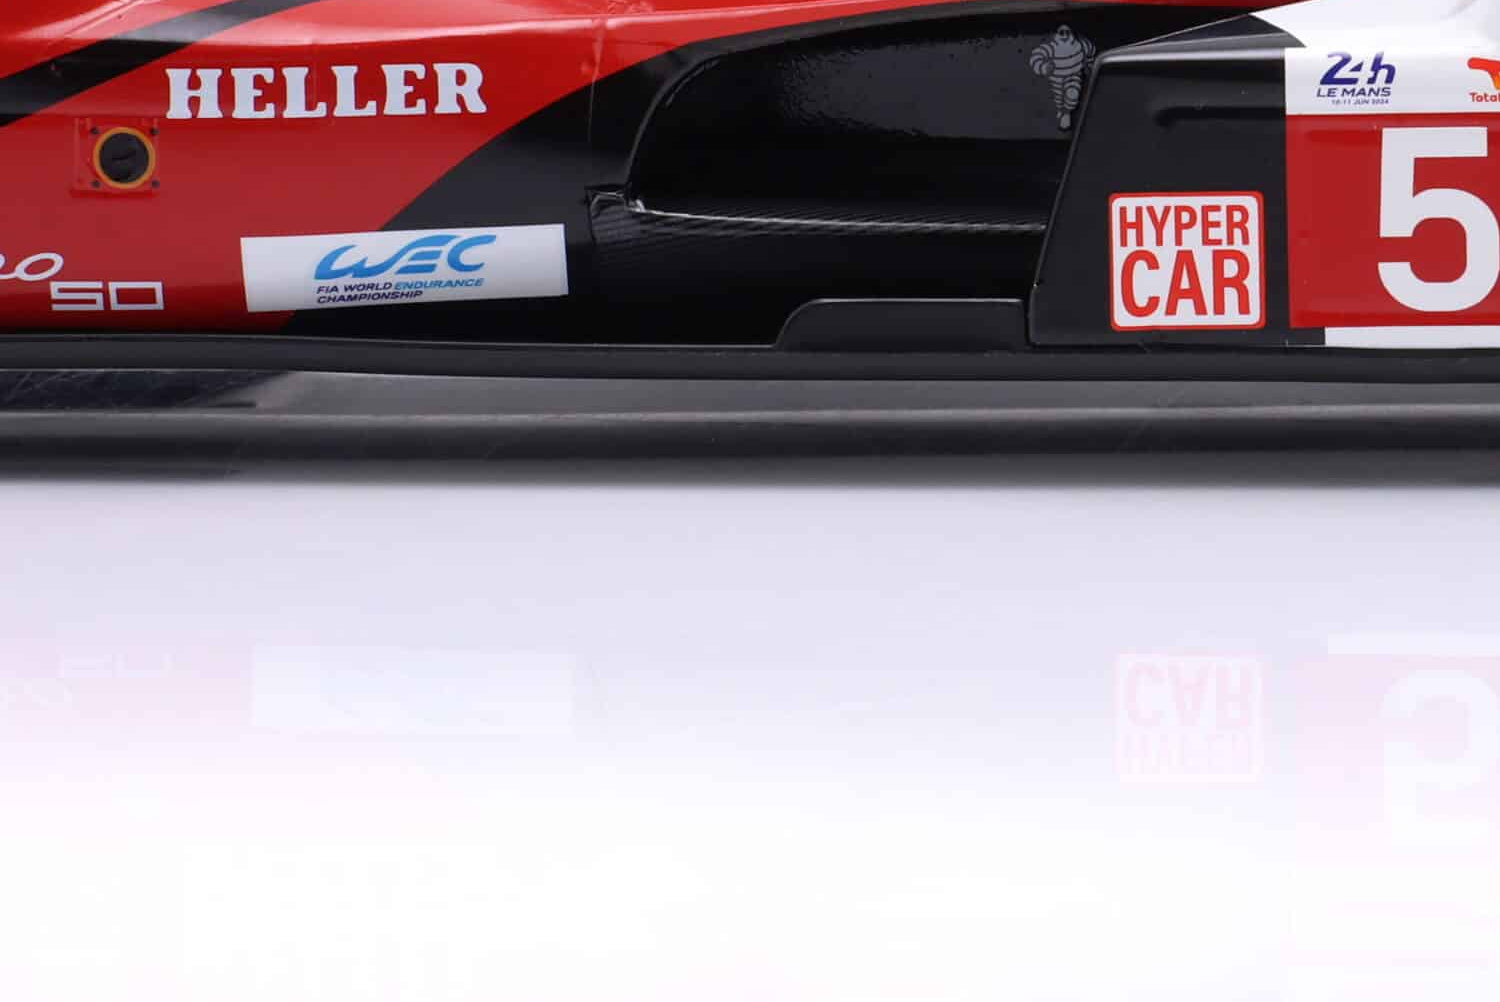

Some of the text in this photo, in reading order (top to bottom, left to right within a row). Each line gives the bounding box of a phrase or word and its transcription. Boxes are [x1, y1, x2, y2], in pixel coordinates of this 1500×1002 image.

[1320, 51, 1396, 85] 24h
[166, 63, 487, 119] HELLER
[1316, 86, 1391, 98] LE MANS
[1119, 205, 1250, 247] HYPER
[1377, 126, 1500, 312] 5
[314, 234, 497, 280] WEC
[50, 281, 165, 311] 50
[316, 277, 485, 295] FIA WORLD ENDURANCE
[317, 290, 423, 304] CHAMPIONSHIP
[1120, 249, 1250, 317] CAR
